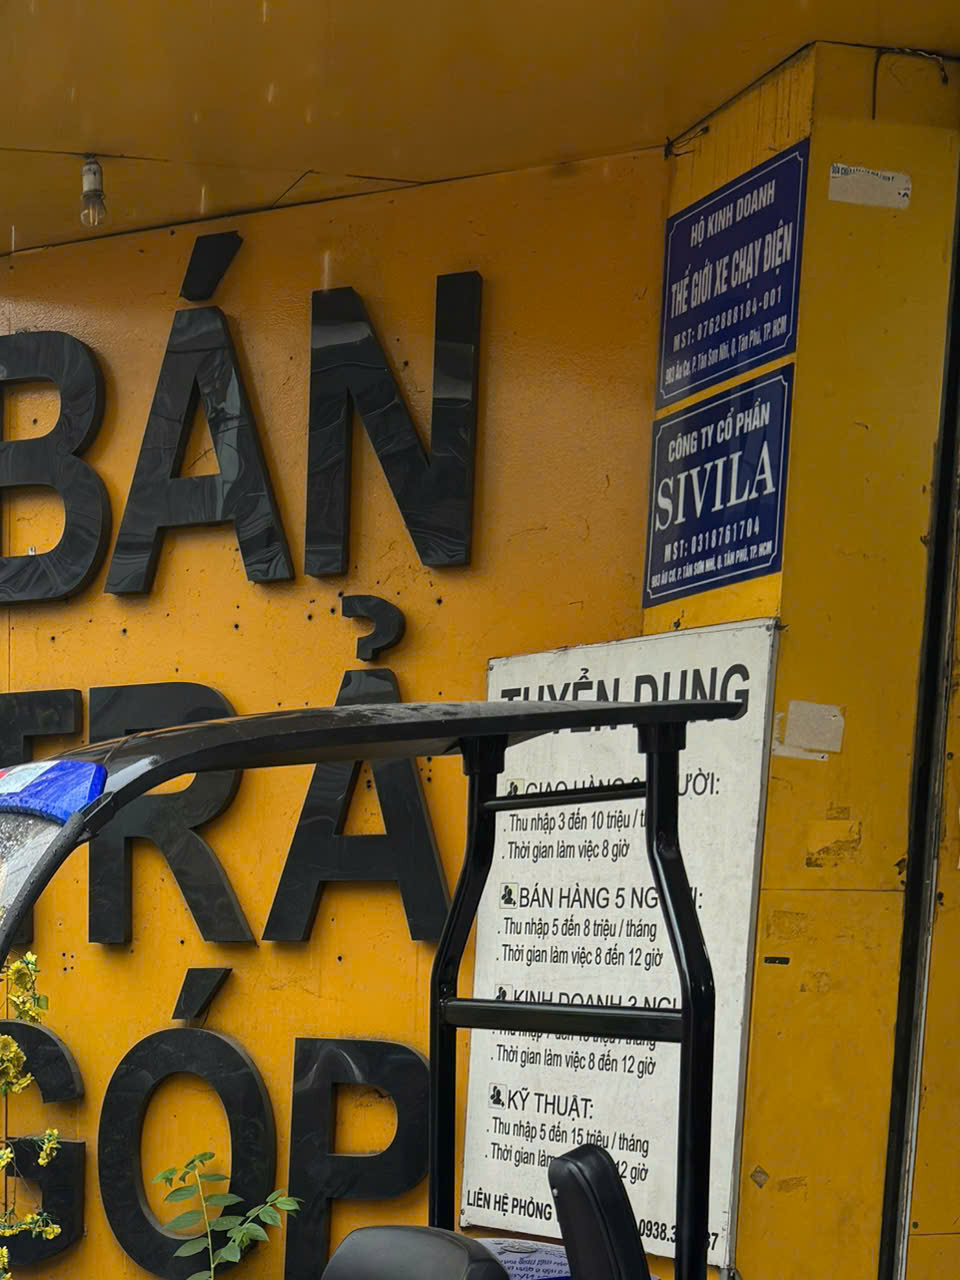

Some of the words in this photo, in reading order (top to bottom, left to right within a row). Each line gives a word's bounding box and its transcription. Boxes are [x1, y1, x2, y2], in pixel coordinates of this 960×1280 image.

[690, 215, 704, 248] HỘ
[707, 200, 733, 238] KINH
[736, 179, 776, 222] DOANH
[671, 263, 691, 319] THẾ
[691, 254, 713, 309] GIỚI
[714, 255, 730, 298] XE
[730, 237, 763, 289] CHẠY
[763, 218, 793, 275] ĐIỆN
[668, 433, 698, 463] CÔNG
[701, 422, 714, 445] TY
[717, 409, 735, 444] CỔ
[736, 397, 771, 435] PHẦN
[655, 440, 776, 532] SIVILA
[678, 768, 721, 796] ƯỜI:
[509, 813, 528, 832] Thu
[530, 812, 555, 836] nhập
[558, 812, 566, 830] 3
[567, 807, 587, 830] đến
[591, 811, 604, 830] 10
[606, 810, 630, 833] triệu
[508, 841, 530, 860] Thời
[532, 842, 554, 863] gian
[557, 841, 575, 859] làm
[577, 840, 599, 863] việc
[601, 840, 609, 858] 8
[611, 838, 630, 863] giờ
[519, 882, 553, 908] BÁN
[558, 882, 610, 909] HÀNG
[615, 887, 625, 908] 5
[504, 917, 522, 935] Thu
[524, 917, 549, 940] nhập
[552, 918, 559, 936] 5
[561, 914, 580, 937] đến
[583, 918, 590, 937] 8
[592, 918, 616, 941] triệu
[625, 918, 657, 943] tháng
[502, 943, 524, 962] Thời
[526, 946, 548, 967] gian
[550, 945, 568, 964] làm
[571, 946, 592, 968] việc
[594, 947, 602, 965] 8
[604, 943, 624, 967] đến
[629, 947, 641, 967] 12
[644, 947, 664, 971] giờ
[496, 1044, 518, 1064] Thời
[520, 1047, 541, 1068] gian
[544, 1047, 562, 1068] làm
[565, 1051, 586, 1074] việc
[588, 1052, 595, 1071] 8
[598, 1049, 618, 1072] đến
[622, 1055, 635, 1074] 12
[637, 1055, 657, 1079] giờ
[507, 1087, 530, 1111] KỸ
[534, 1092, 594, 1121] THUẬT:
[492, 1116, 510, 1136] Thu
[512, 1119, 537, 1142] nhập
[539, 1123, 546, 1141] 5
[548, 1120, 568, 1144] đến
[571, 1127, 584, 1146] 15
[586, 1129, 609, 1150] triệu
[618, 1132, 649, 1158] tháng
[491, 1142, 512, 1161] Thời
[514, 1147, 536, 1167] gian
[630, 1162, 650, 1185] giờ
[467, 1187, 491, 1210] LIÊN
[493, 1193, 509, 1217] HỆ
